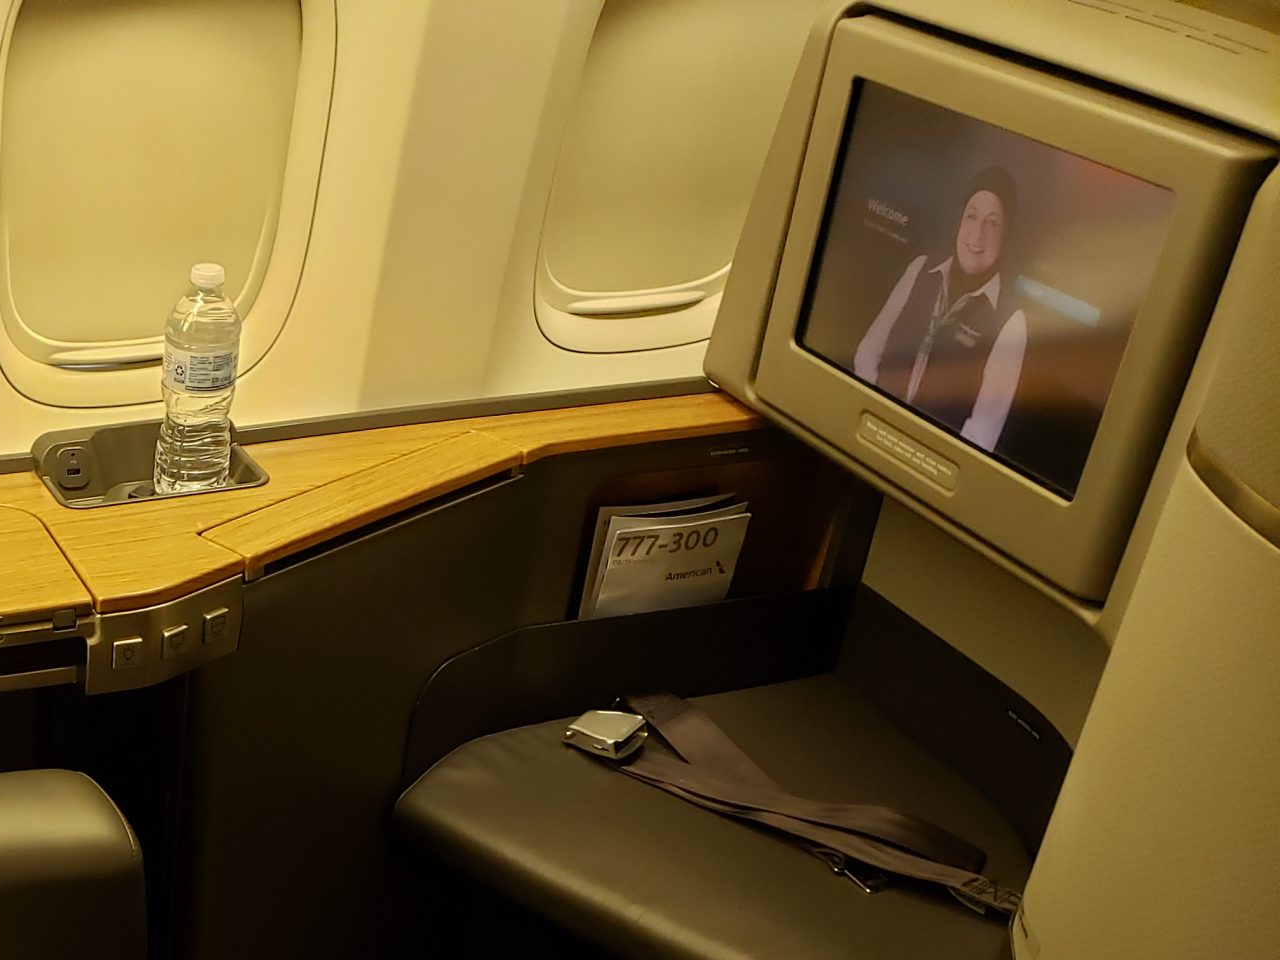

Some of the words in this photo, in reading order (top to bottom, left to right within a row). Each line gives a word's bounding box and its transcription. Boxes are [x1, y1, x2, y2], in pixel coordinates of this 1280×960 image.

[868, 198, 909, 226] Welcome
[616, 527, 719, 558] 777-300
[665, 566, 713, 582] American
